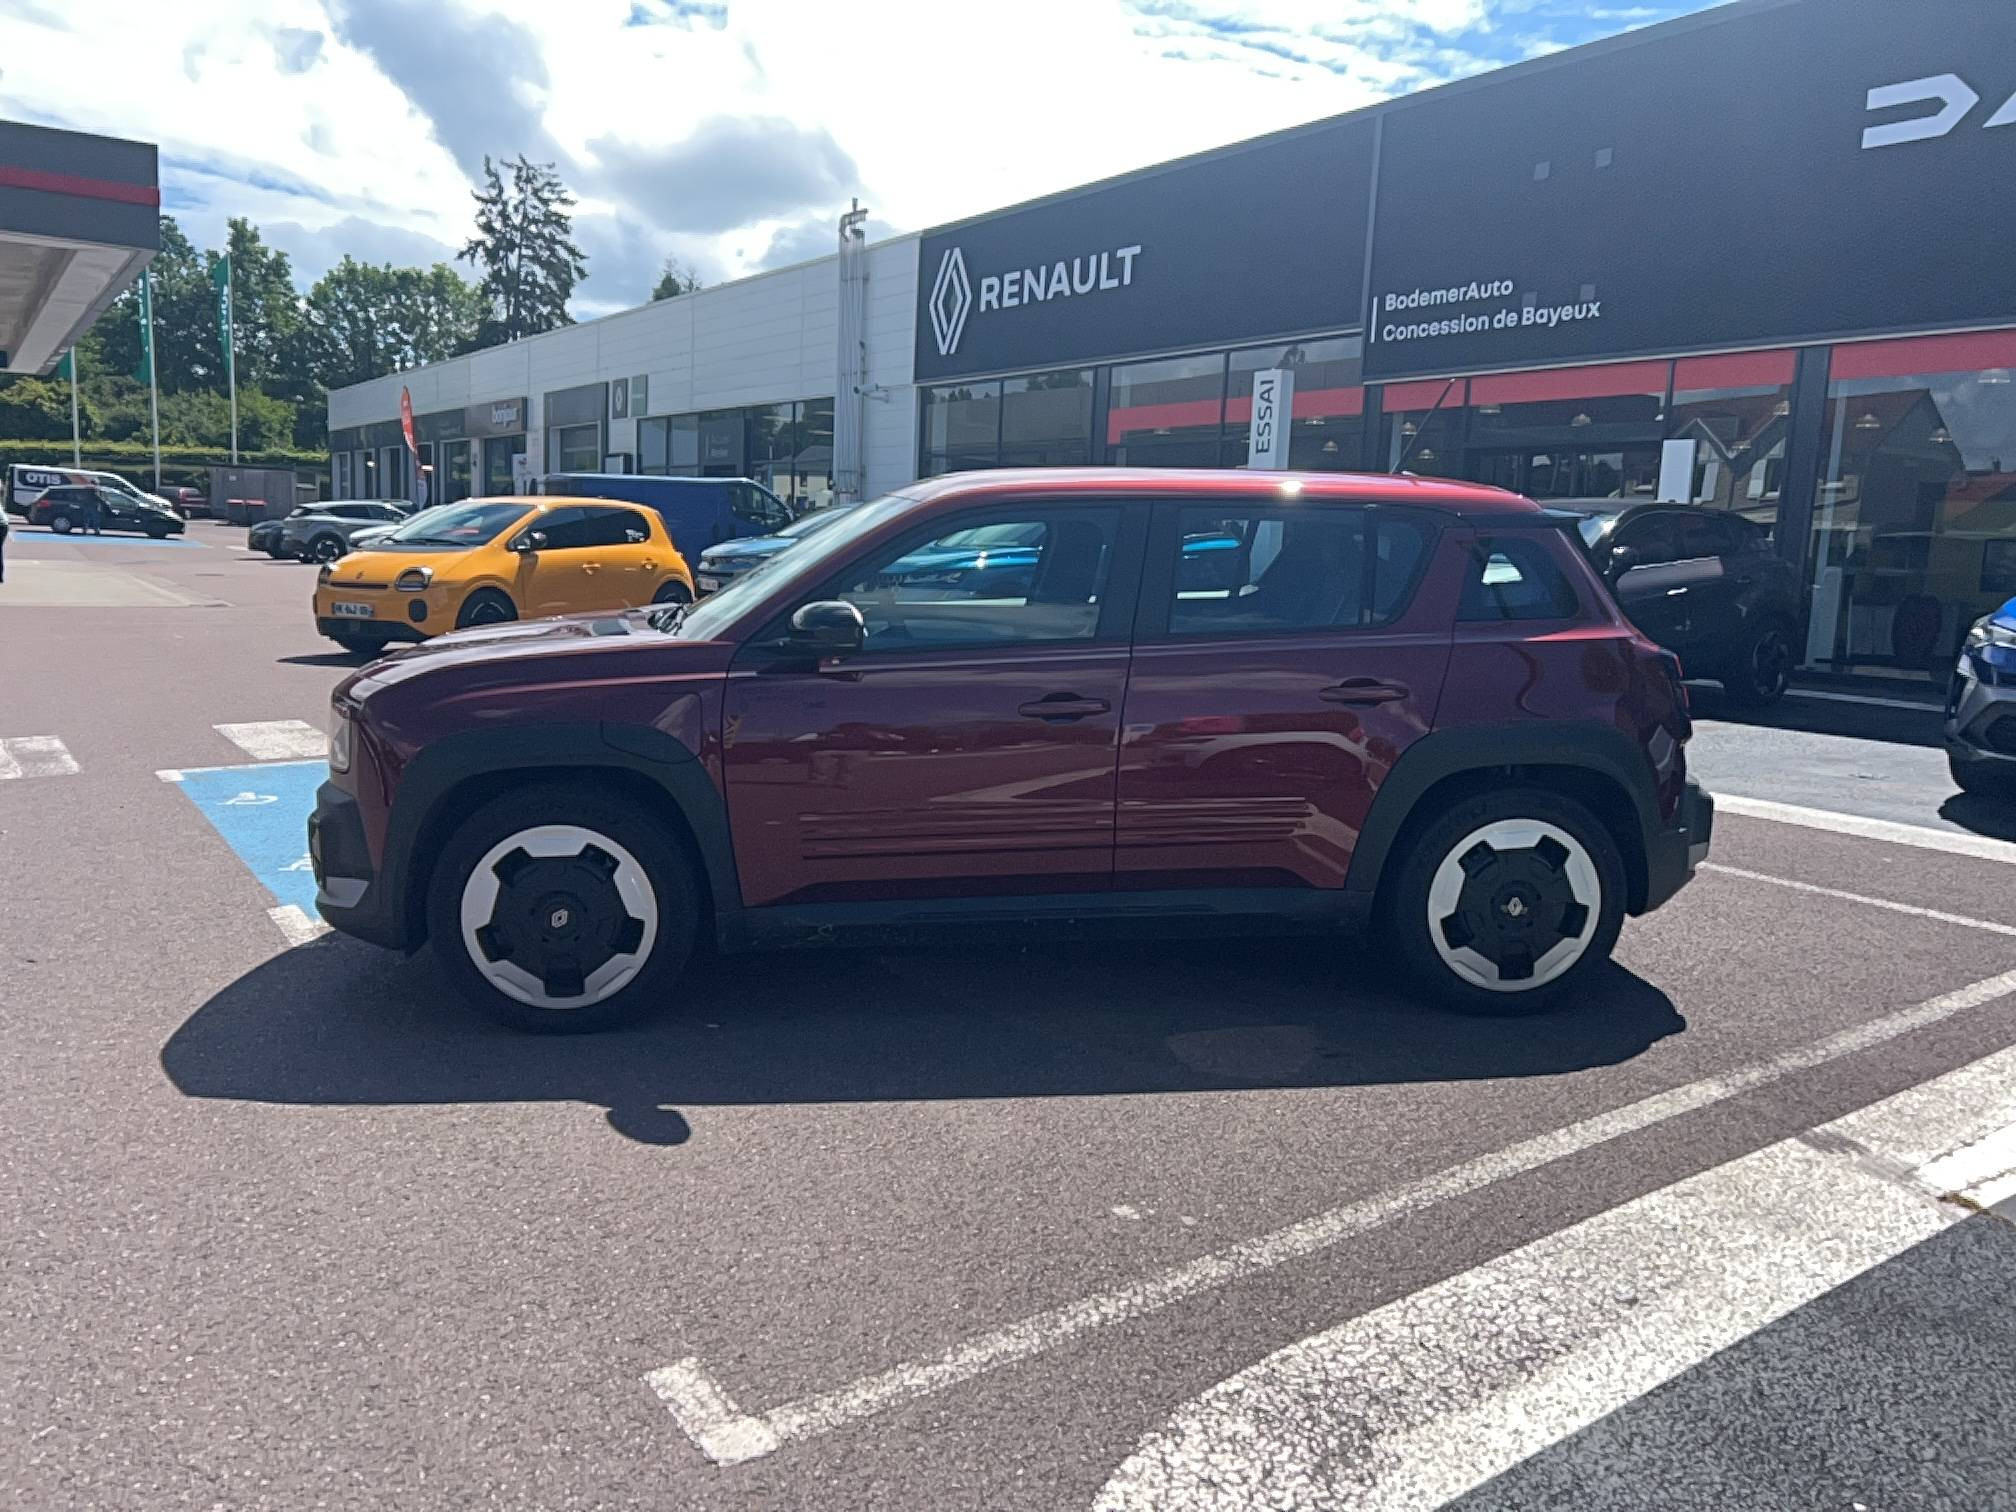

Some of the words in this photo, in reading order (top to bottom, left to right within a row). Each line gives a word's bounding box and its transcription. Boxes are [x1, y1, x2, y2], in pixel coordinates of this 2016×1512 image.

[1861, 73, 2016, 149] D
[979, 244, 1142, 312] RENAULT
[1384, 279, 1514, 311] BodemerAuto
[1382, 314, 1489, 342] Concession
[1493, 309, 1518, 329] de
[1521, 301, 1601, 327] Bayeux
[1255, 379, 1275, 455] ESSAI
[25, 472, 61, 485] OTIS
